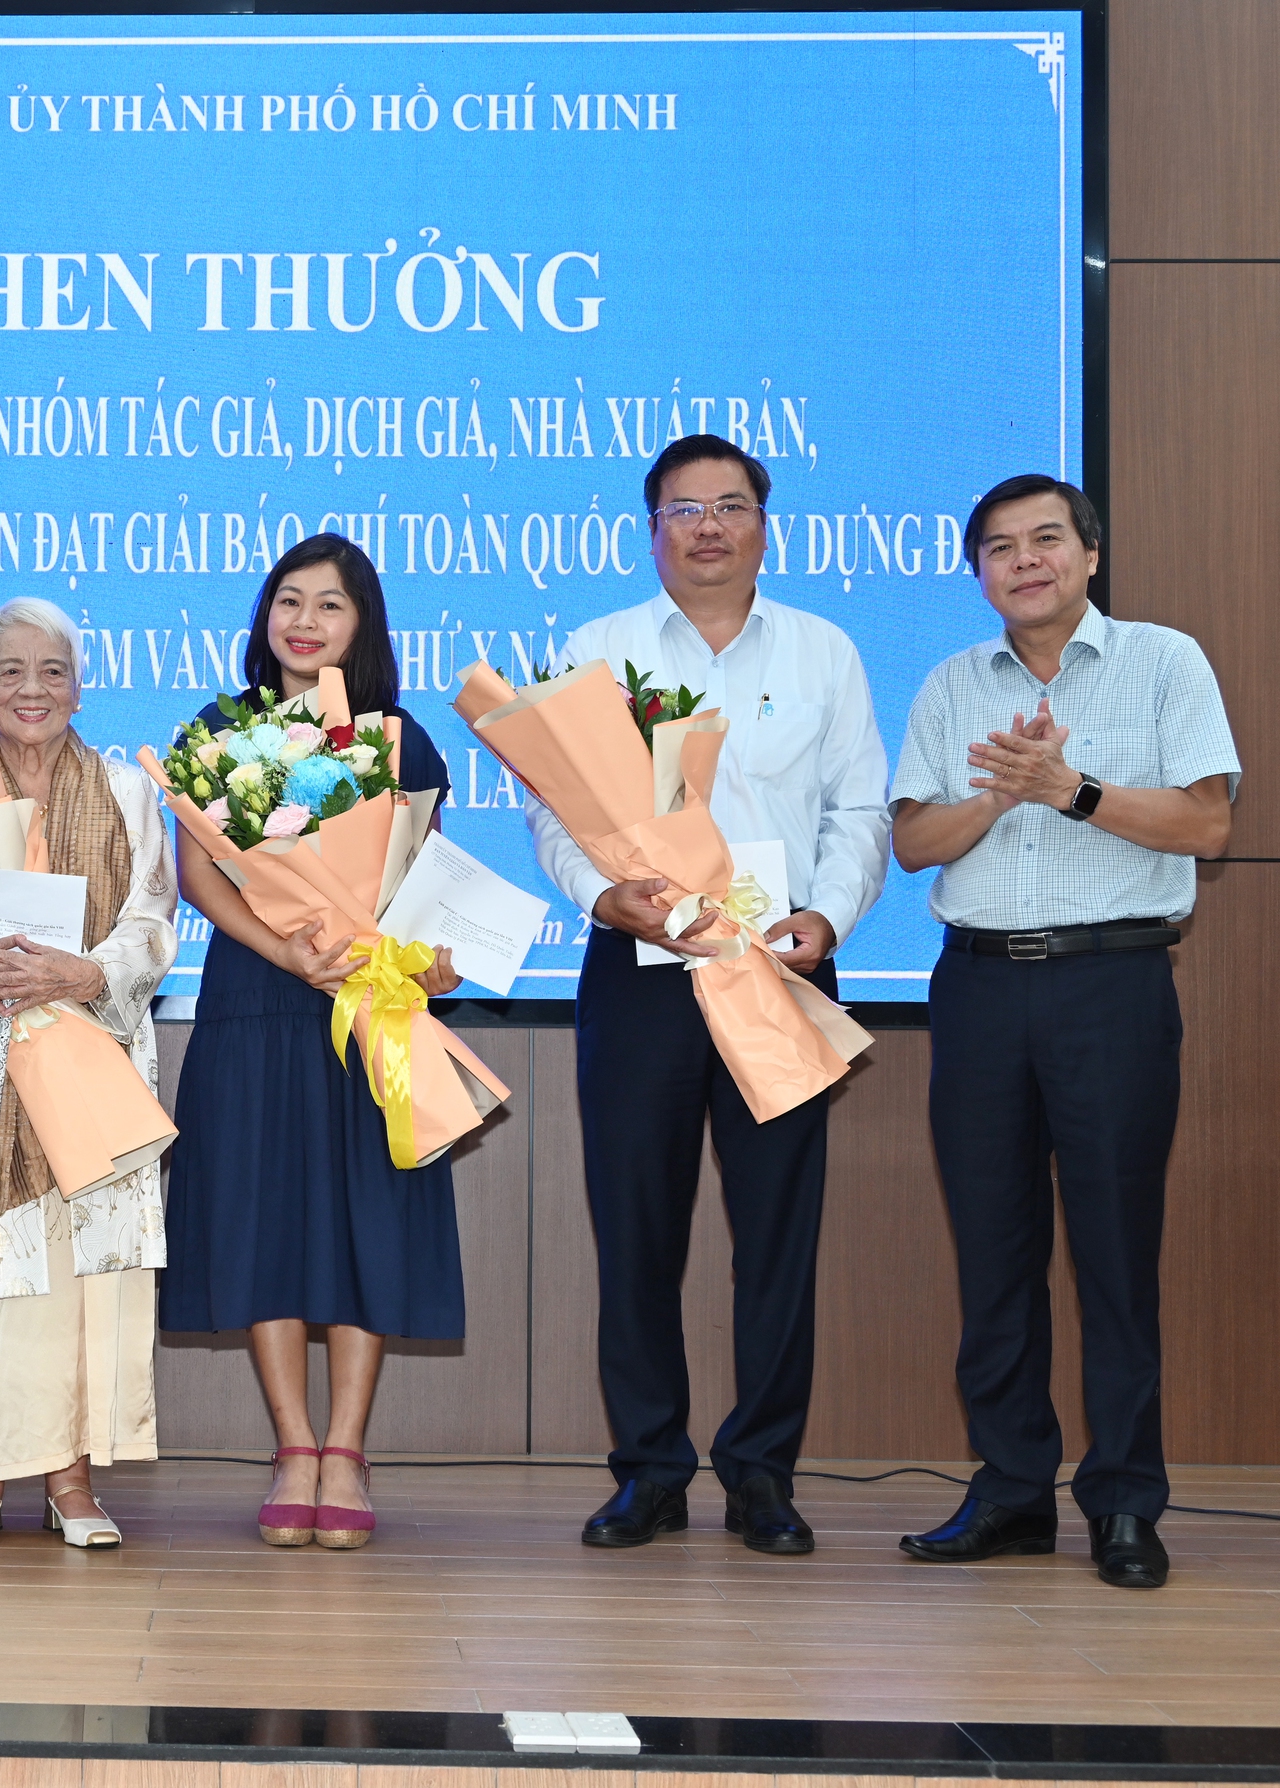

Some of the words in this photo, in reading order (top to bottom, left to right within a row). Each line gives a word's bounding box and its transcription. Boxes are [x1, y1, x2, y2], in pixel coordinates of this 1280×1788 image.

[10, 83, 71, 133] ỦY
[82, 83, 245, 133] THÀNH
[261, 82, 357, 133] PHỐ
[372, 82, 440, 133] HỒ
[452, 82, 535, 132] CHÍ
[551, 93, 678, 132] MINH
[186, 226, 607, 334] THƯỞNG
[121, 378, 201, 459] TÁC
[212, 378, 293, 470] GIẢ,
[304, 396, 405, 476] DỊCH
[416, 378, 499, 471] GIẢ,
[508, 377, 595, 458] NHÀ
[606, 377, 716, 457] XUẤT
[726, 377, 818, 471] BẢN,
[32, 511, 115, 590] ĐẠT
[124, 493, 212, 574] GIẢI
[221, 492, 306, 574] BÁO
[398, 493, 510, 575] TOÀN
[520, 494, 637, 590] QUỐC
[804, 502, 924, 594] DỰNG
